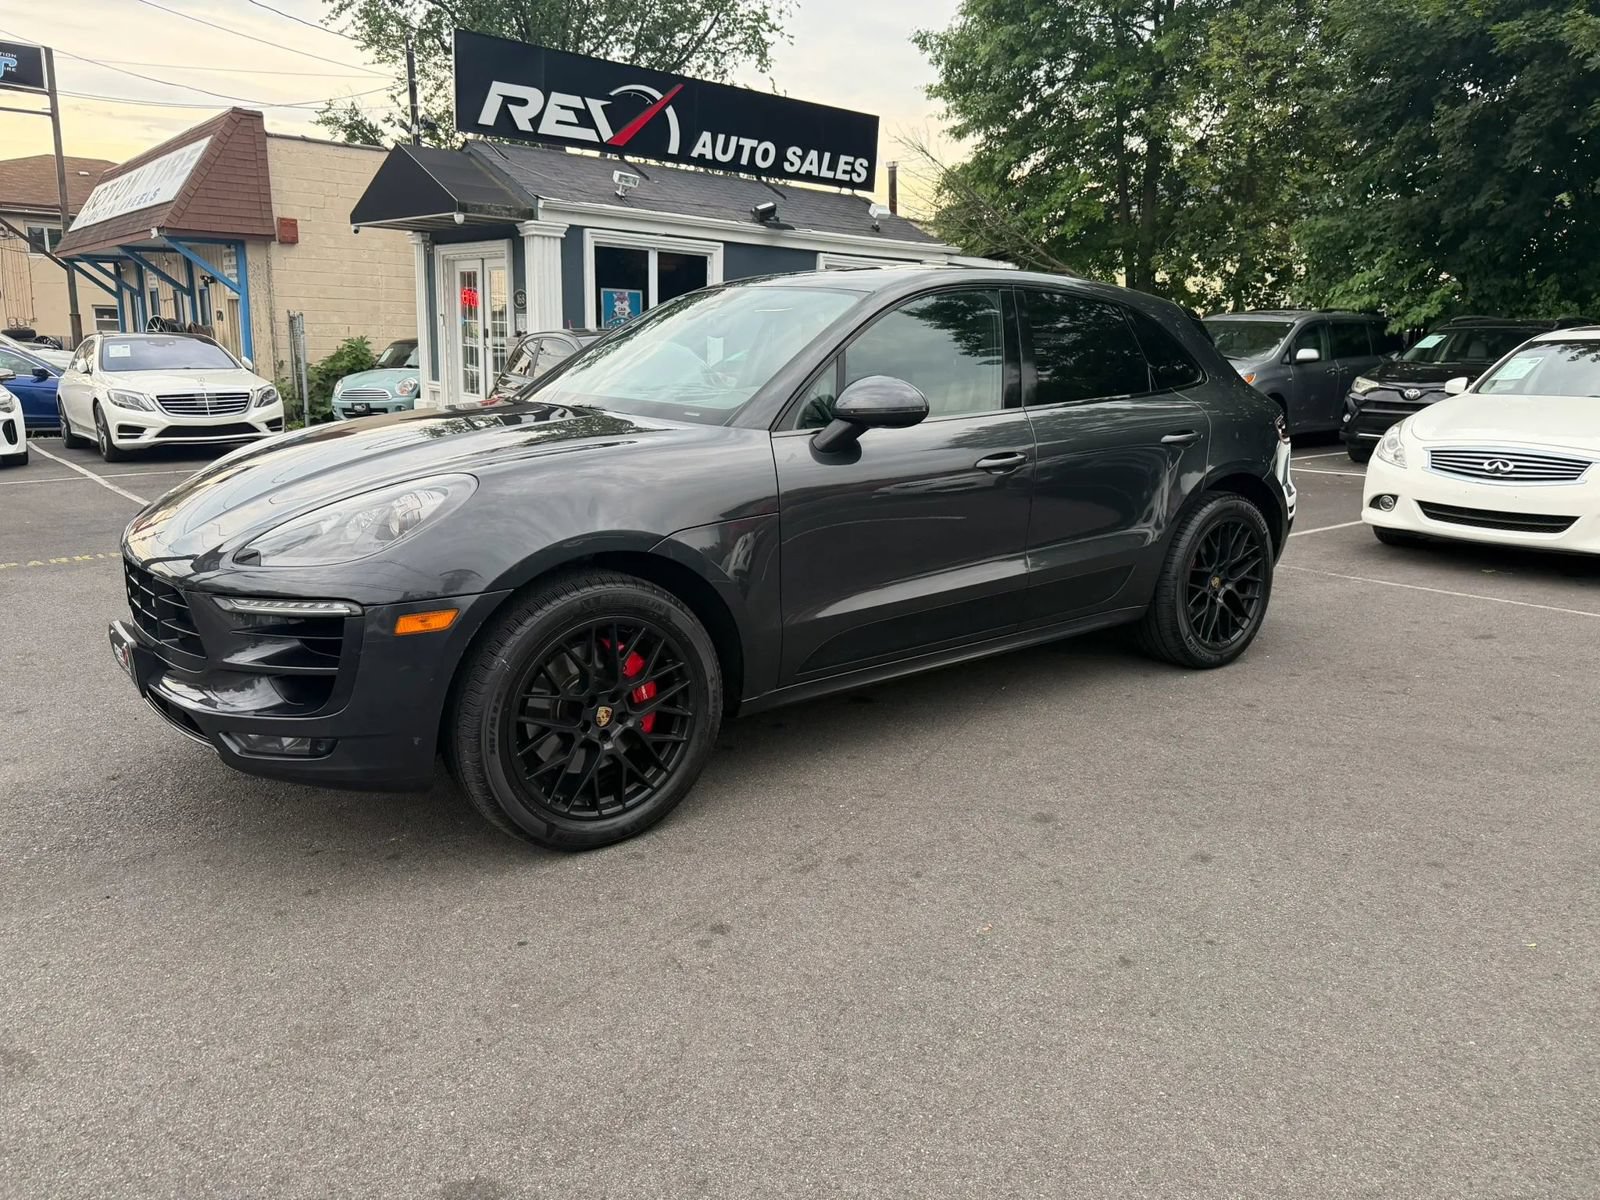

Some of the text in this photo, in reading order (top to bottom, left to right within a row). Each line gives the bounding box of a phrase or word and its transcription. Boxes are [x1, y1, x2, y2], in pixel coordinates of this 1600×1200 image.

[477, 79, 684, 148] REV
[79, 142, 205, 213] ACTION TIRE
[689, 130, 870, 185] AUTO SALES
